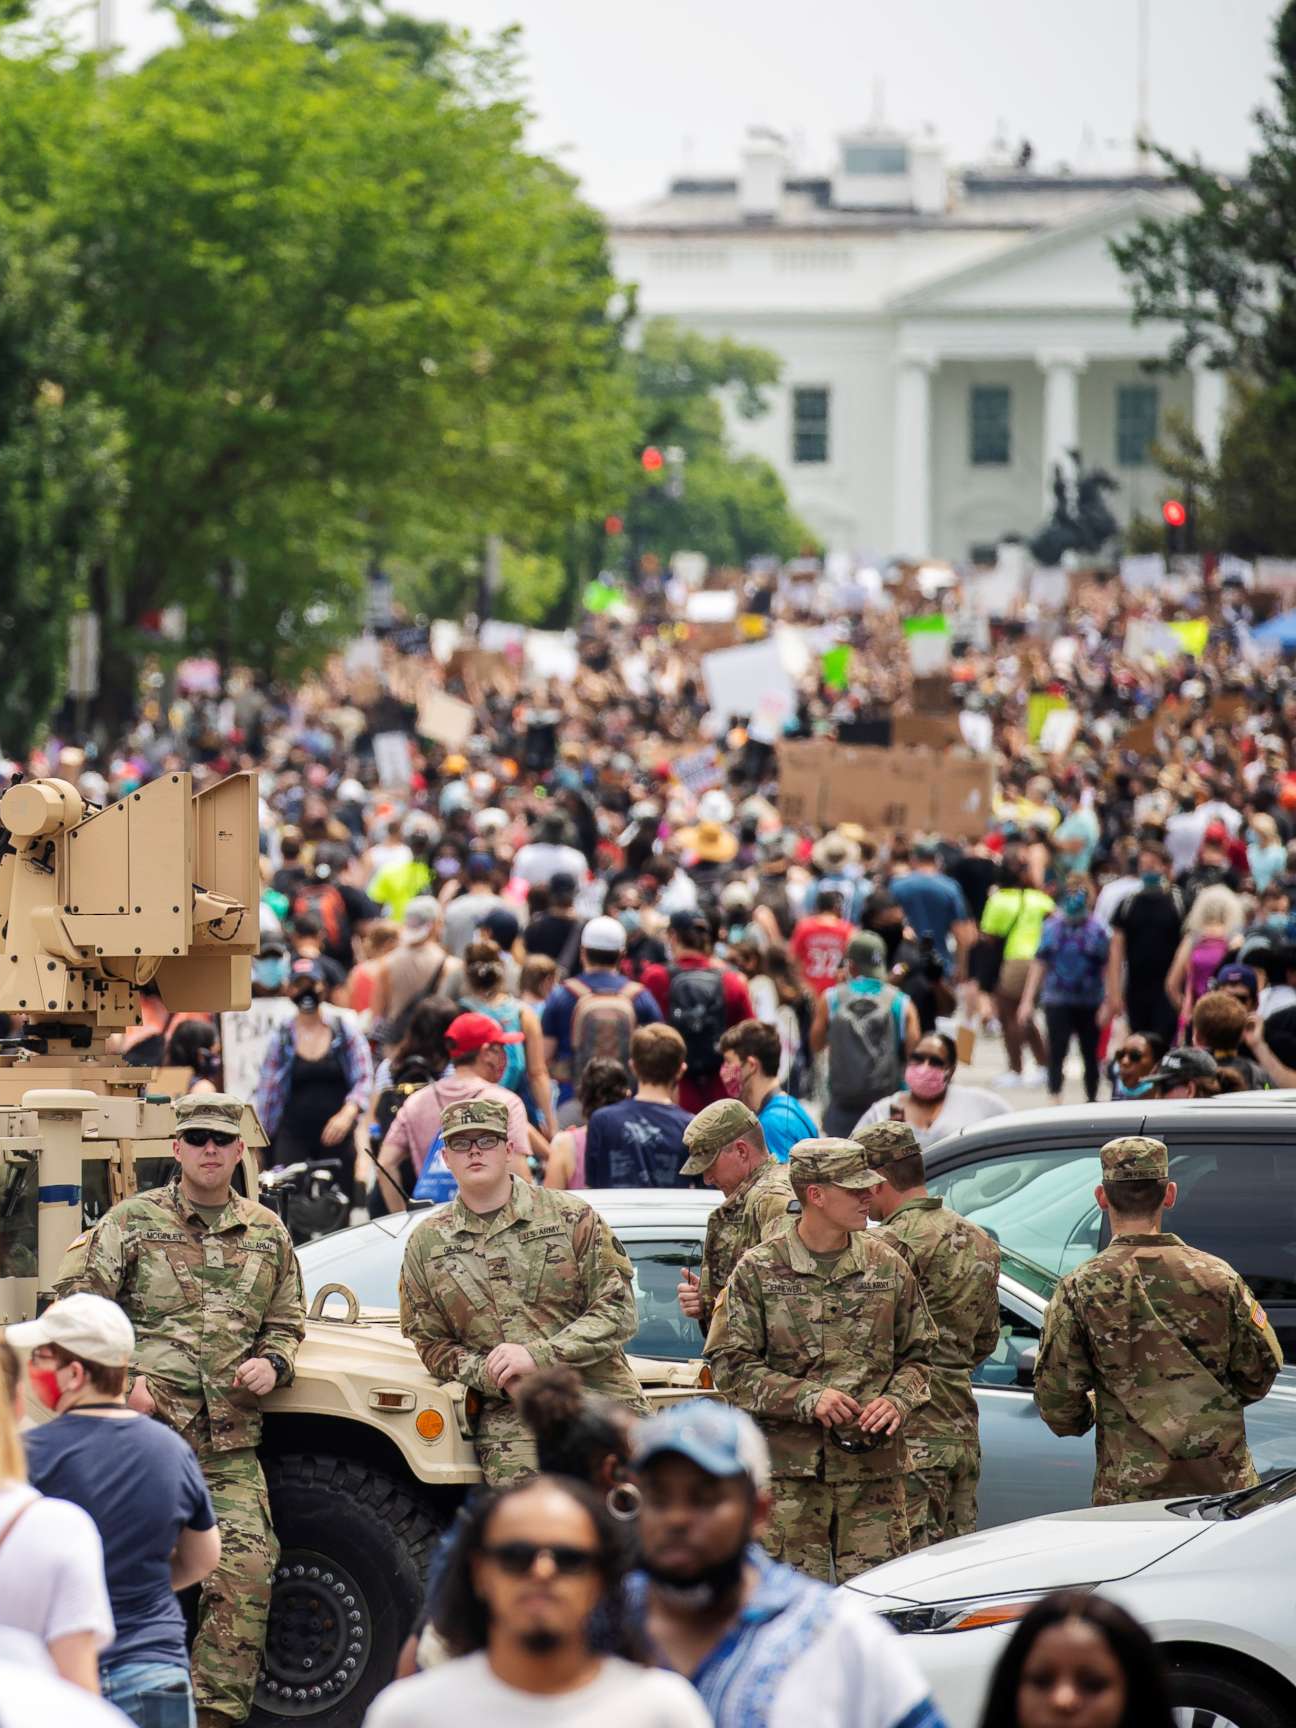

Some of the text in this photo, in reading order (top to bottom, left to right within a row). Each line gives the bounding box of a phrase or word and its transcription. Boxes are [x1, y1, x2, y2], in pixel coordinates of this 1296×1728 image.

[538, 1224, 561, 1236] ARMY
[255, 1242, 273, 1251] ARMY
[872, 1281, 889, 1290] ARMY
